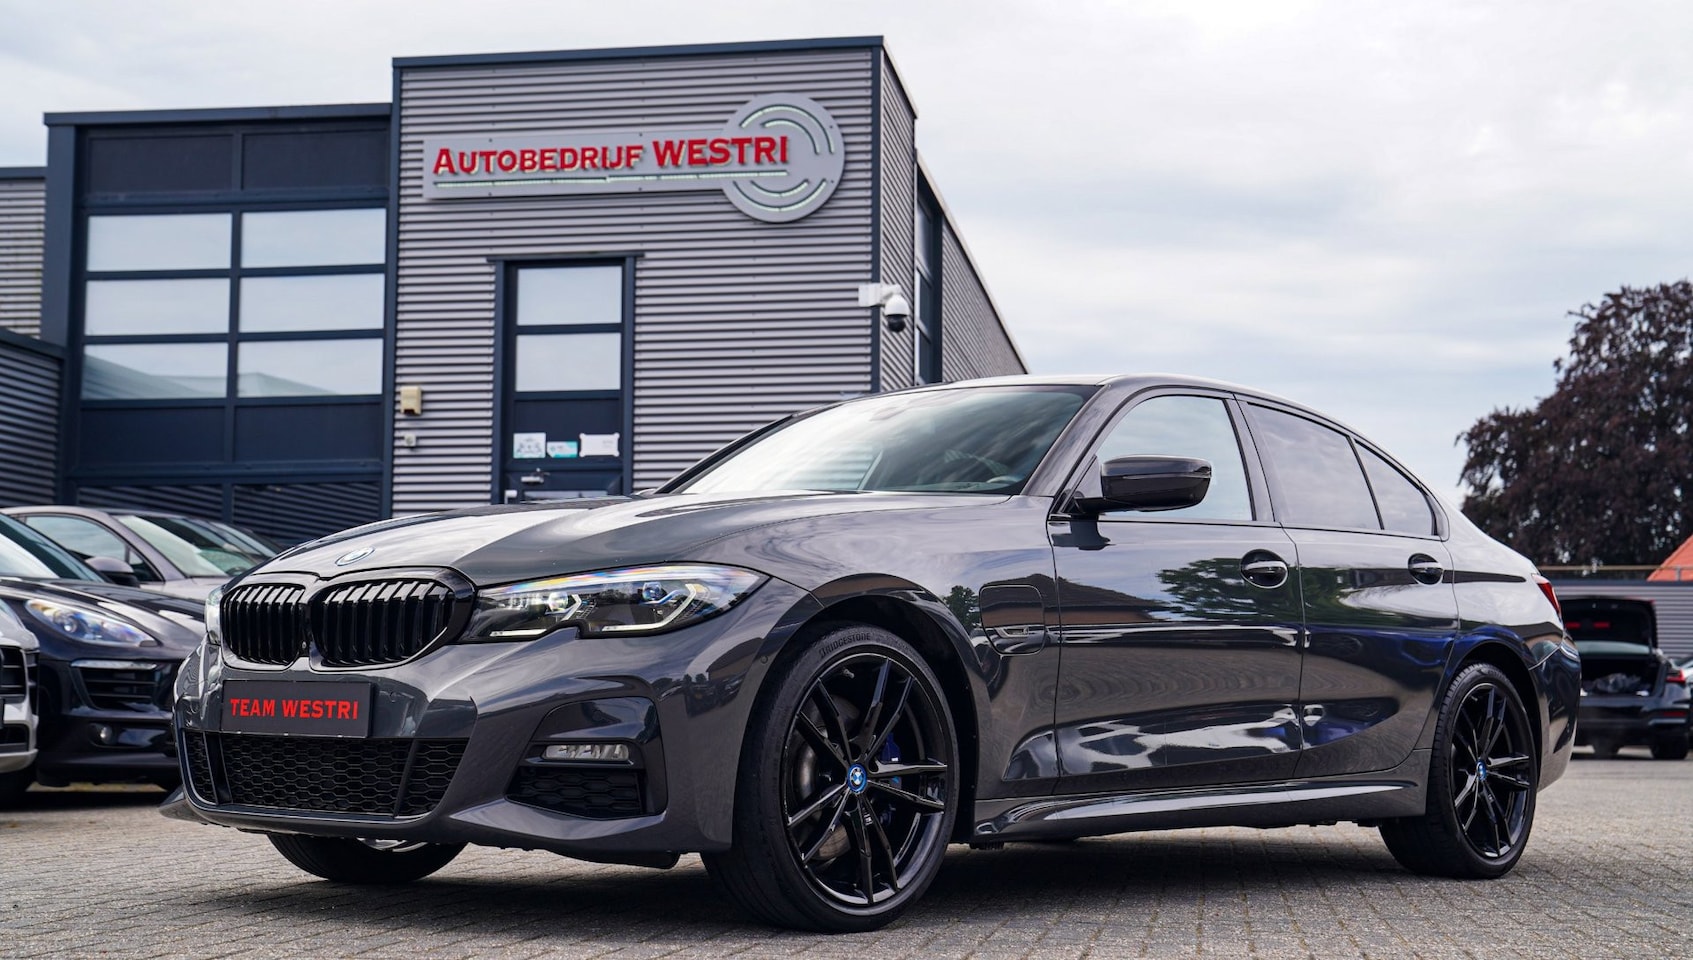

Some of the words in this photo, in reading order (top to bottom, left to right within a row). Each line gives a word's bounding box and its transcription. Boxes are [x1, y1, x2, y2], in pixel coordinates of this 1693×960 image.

[433, 145, 644, 174] AUTOBEDRIJF
[653, 135, 789, 167] WESTRI
[230, 698, 276, 717] TEAM
[281, 699, 359, 720] WESTRI
